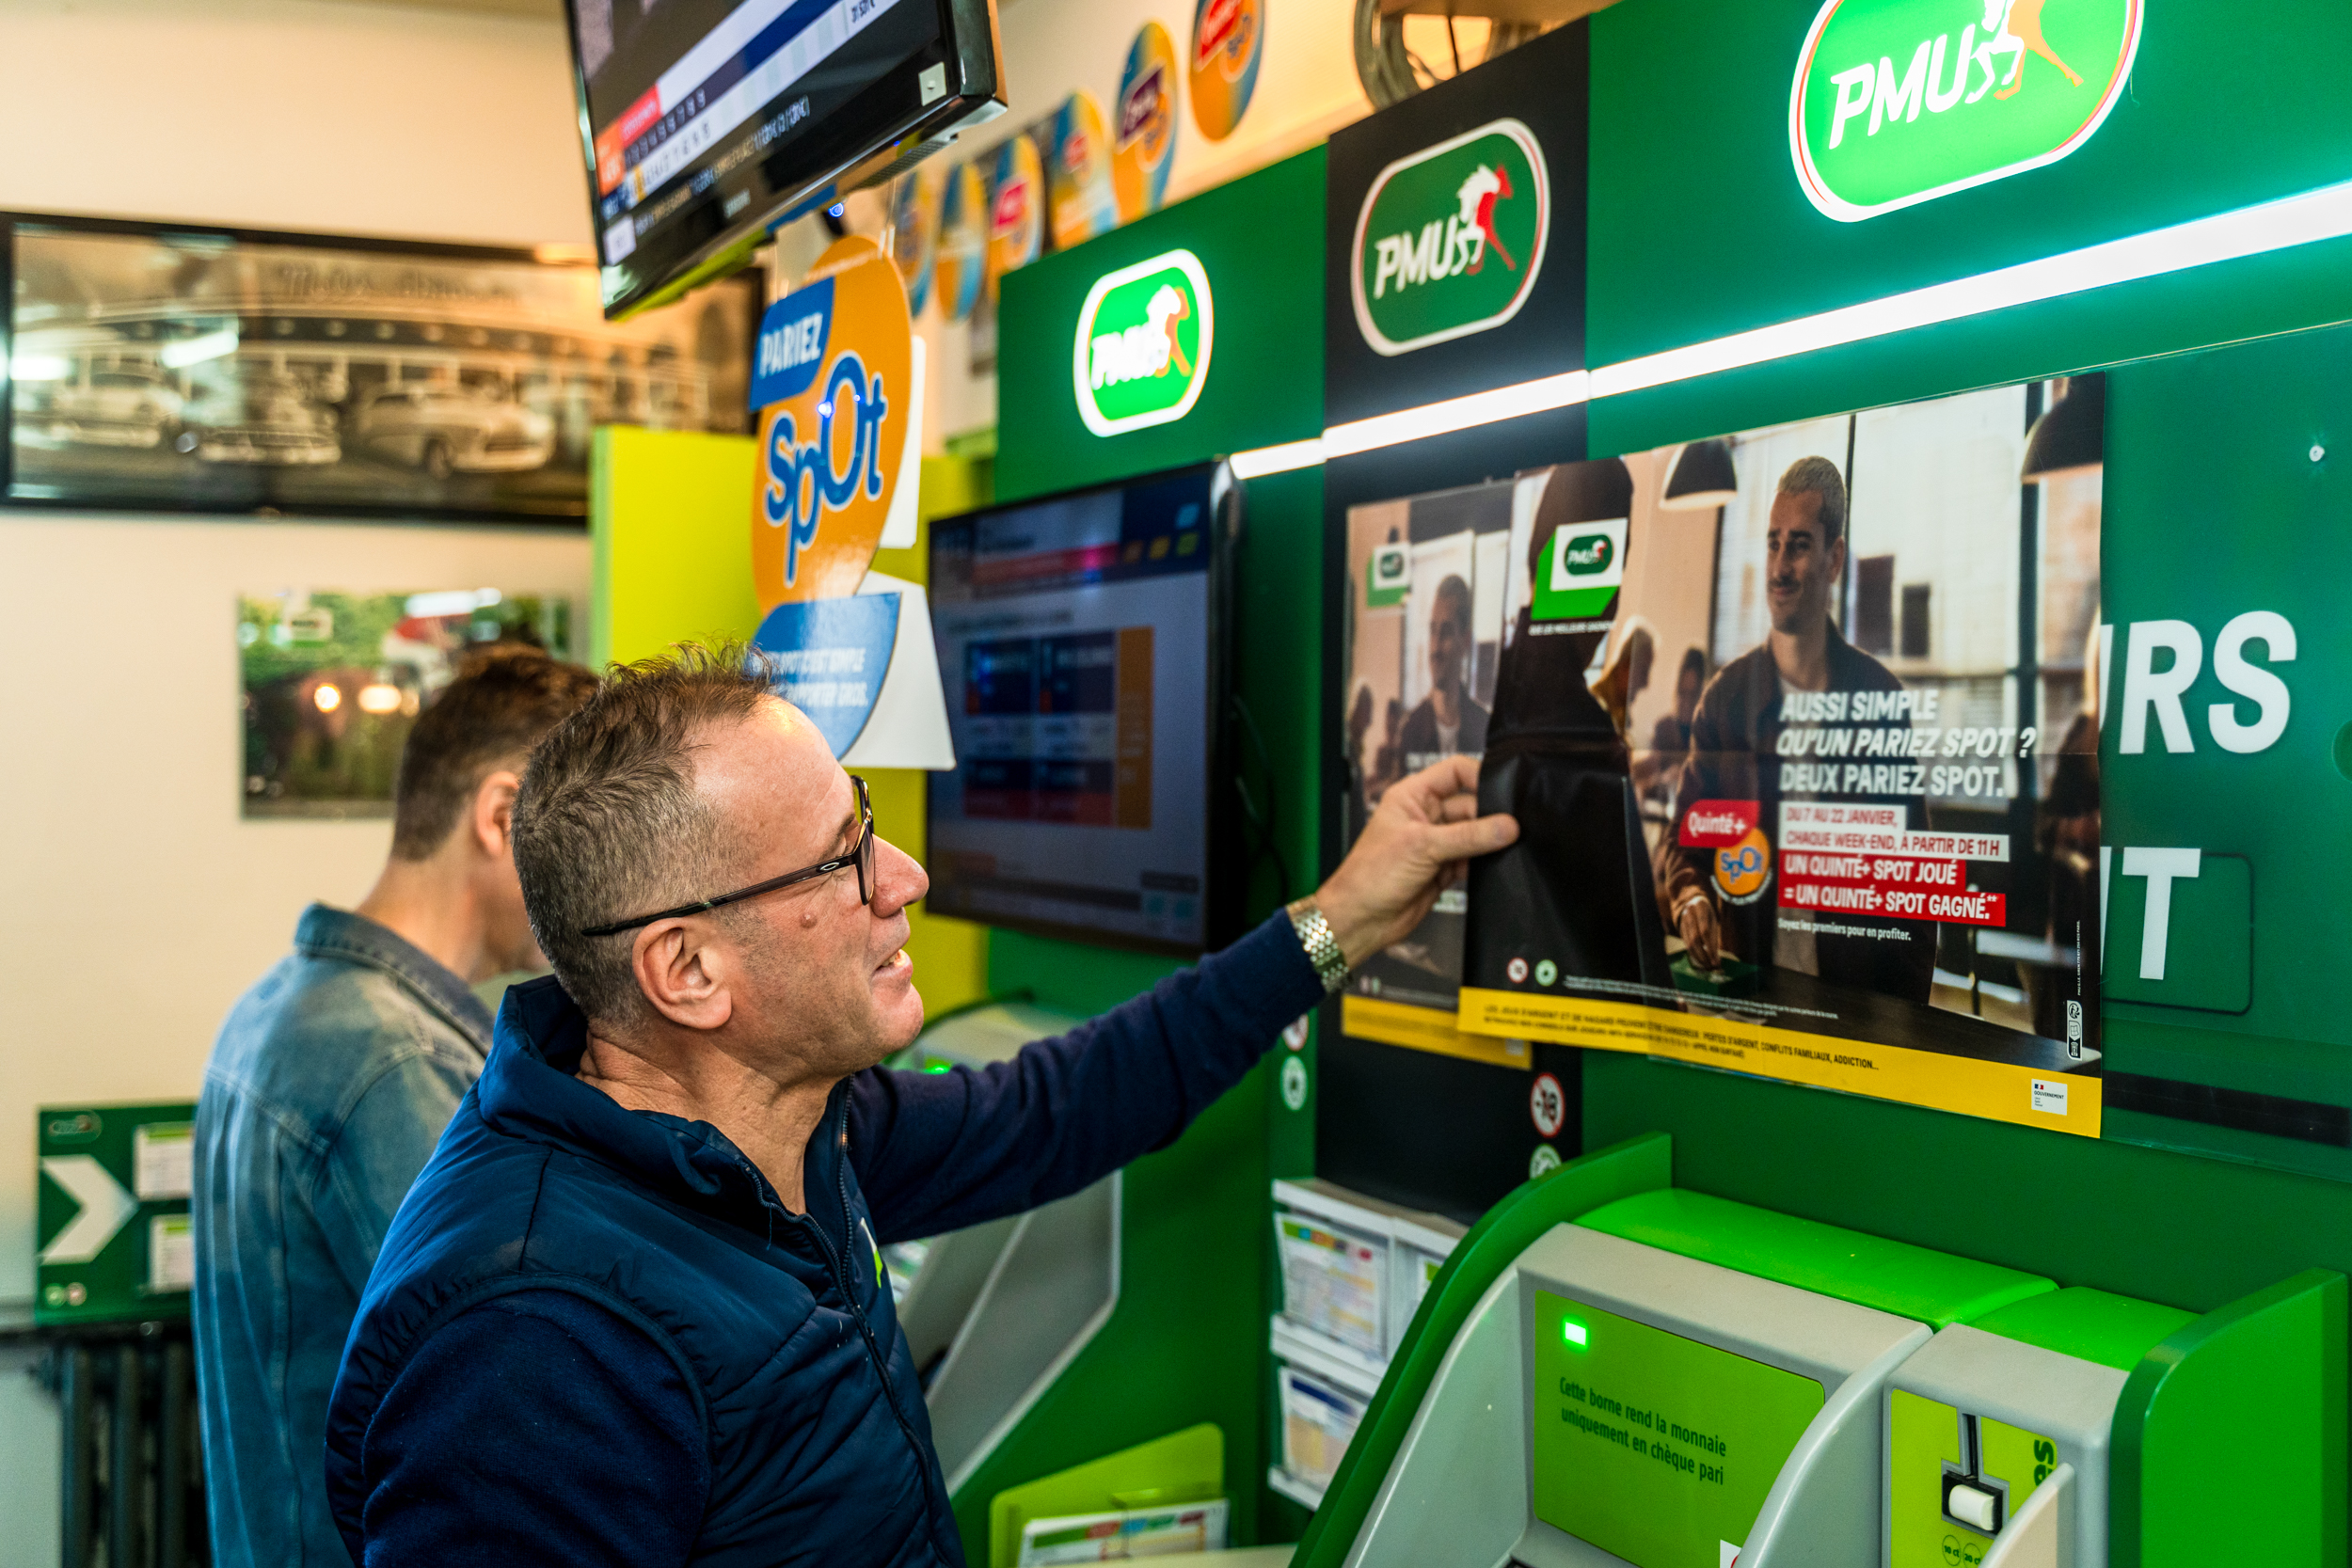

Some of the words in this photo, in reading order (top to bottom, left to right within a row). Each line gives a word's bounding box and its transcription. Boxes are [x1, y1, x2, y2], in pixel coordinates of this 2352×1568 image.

[1829, 24, 1976, 150] PMU
[1374, 214, 1458, 299] PMU
[759, 312, 823, 377] PARIEZ
[1778, 691, 1850, 722] AUSSI
[1851, 689, 1939, 722] SIMPLE
[1776, 728, 1851, 756] QU'UN
[1853, 728, 1937, 757] PARIEZ
[1941, 727, 2015, 757] SPOT
[2020, 726, 2037, 758] ?
[1779, 763, 1839, 793] DEUX
[1843, 764, 1926, 795] PARIEZ
[1931, 765, 2004, 797] SPOT.
[1787, 807, 1802, 823] DU
[1804, 808, 1812, 823] 7
[1813, 808, 1828, 823] AU
[1831, 809, 1844, 824] 22
[1846, 810, 1898, 828] JANVIER,
[1786, 831, 1832, 847] CHAQUE
[1834, 833, 1897, 853] WEEK-END,
[1900, 832, 1910, 851] À
[1912, 836, 1955, 854] PARTIR
[1958, 838, 1974, 855] DE
[1977, 839, 1988, 855] 11
[1990, 840, 2000, 856] H
[1785, 854, 1808, 876] UN
[1810, 853, 1871, 879] QUINTÉ+
[1873, 861, 1914, 882] SPOT
[1915, 859, 1958, 885] JOUÉ
[1796, 885, 1820, 905] UN
[1820, 884, 1883, 910] QUINTÉ+
[1885, 891, 1926, 913] SPOT
[1802, 921, 1812, 931] les
[1812, 923, 1846, 936] premiers
[1847, 926, 1866, 938] pour
[1867, 929, 1877, 938] en
[1878, 927, 1912, 941] profiter.
[1760, 1041, 1792, 1055] CONFLITS
[1794, 1047, 1833, 1064] FAMILIAUX,
[1834, 1053, 1879, 1069] ADDICTION...
[2034, 1090, 2064, 1100] GOUVERNEMENT
[1560, 1377, 1586, 1402] Cette
[1590, 1387, 1622, 1417] borne
[1626, 1404, 1652, 1429] rend
[1656, 1413, 1667, 1434] la
[1671, 1423, 1726, 1457] monnaie
[1561, 1407, 1629, 1449] uniquement
[1632, 1436, 1646, 1455] en
[1651, 1441, 1694, 1474] chèque
[1699, 1463, 1724, 1485] pari
